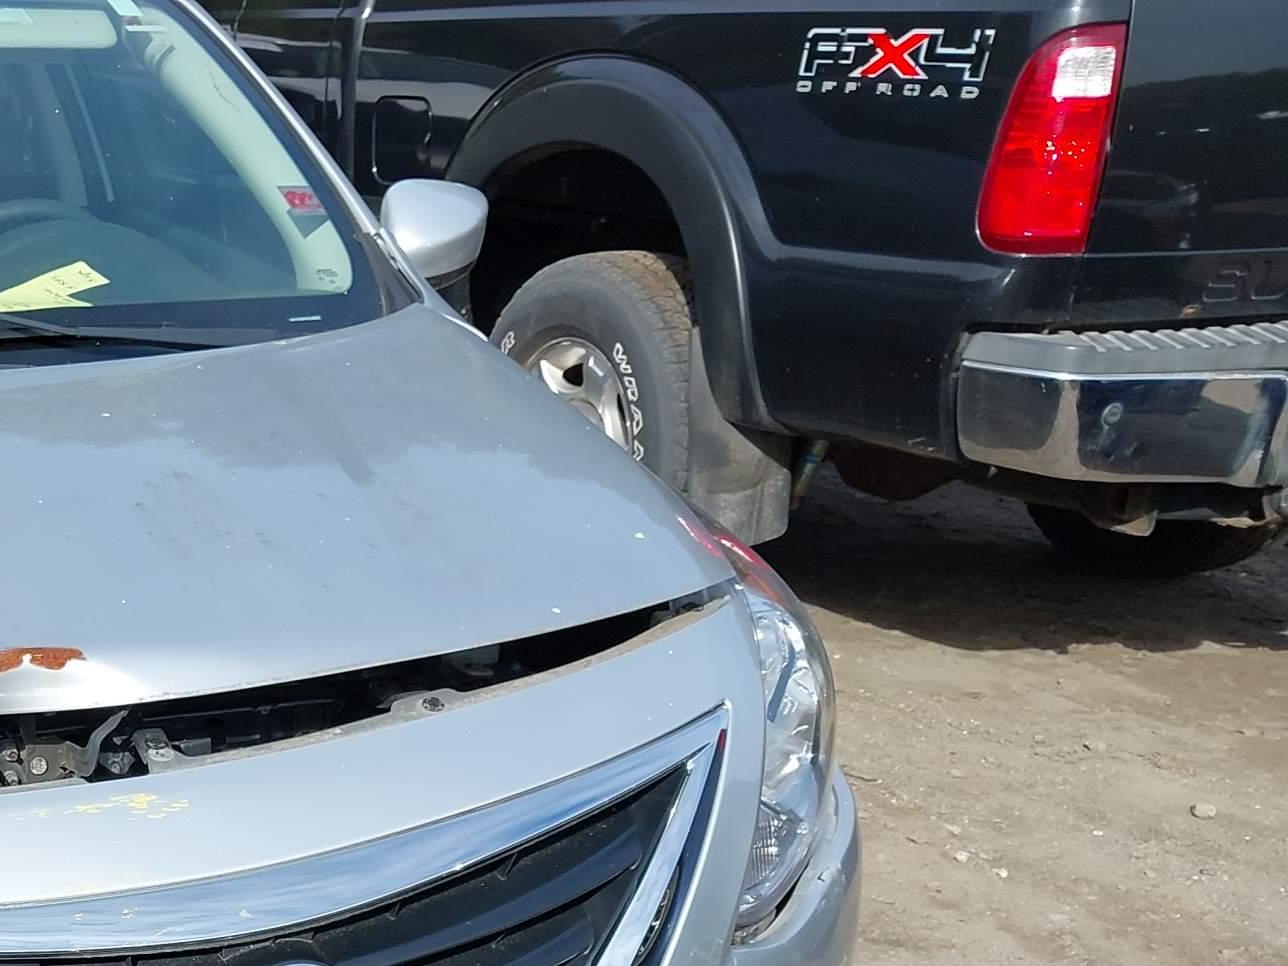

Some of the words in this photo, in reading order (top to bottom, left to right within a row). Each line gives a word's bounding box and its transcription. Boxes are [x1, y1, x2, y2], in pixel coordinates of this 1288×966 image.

[798, 28, 997, 82] FX4
[796, 80, 859, 95] OFF
[875, 82, 980, 99] ROAD
